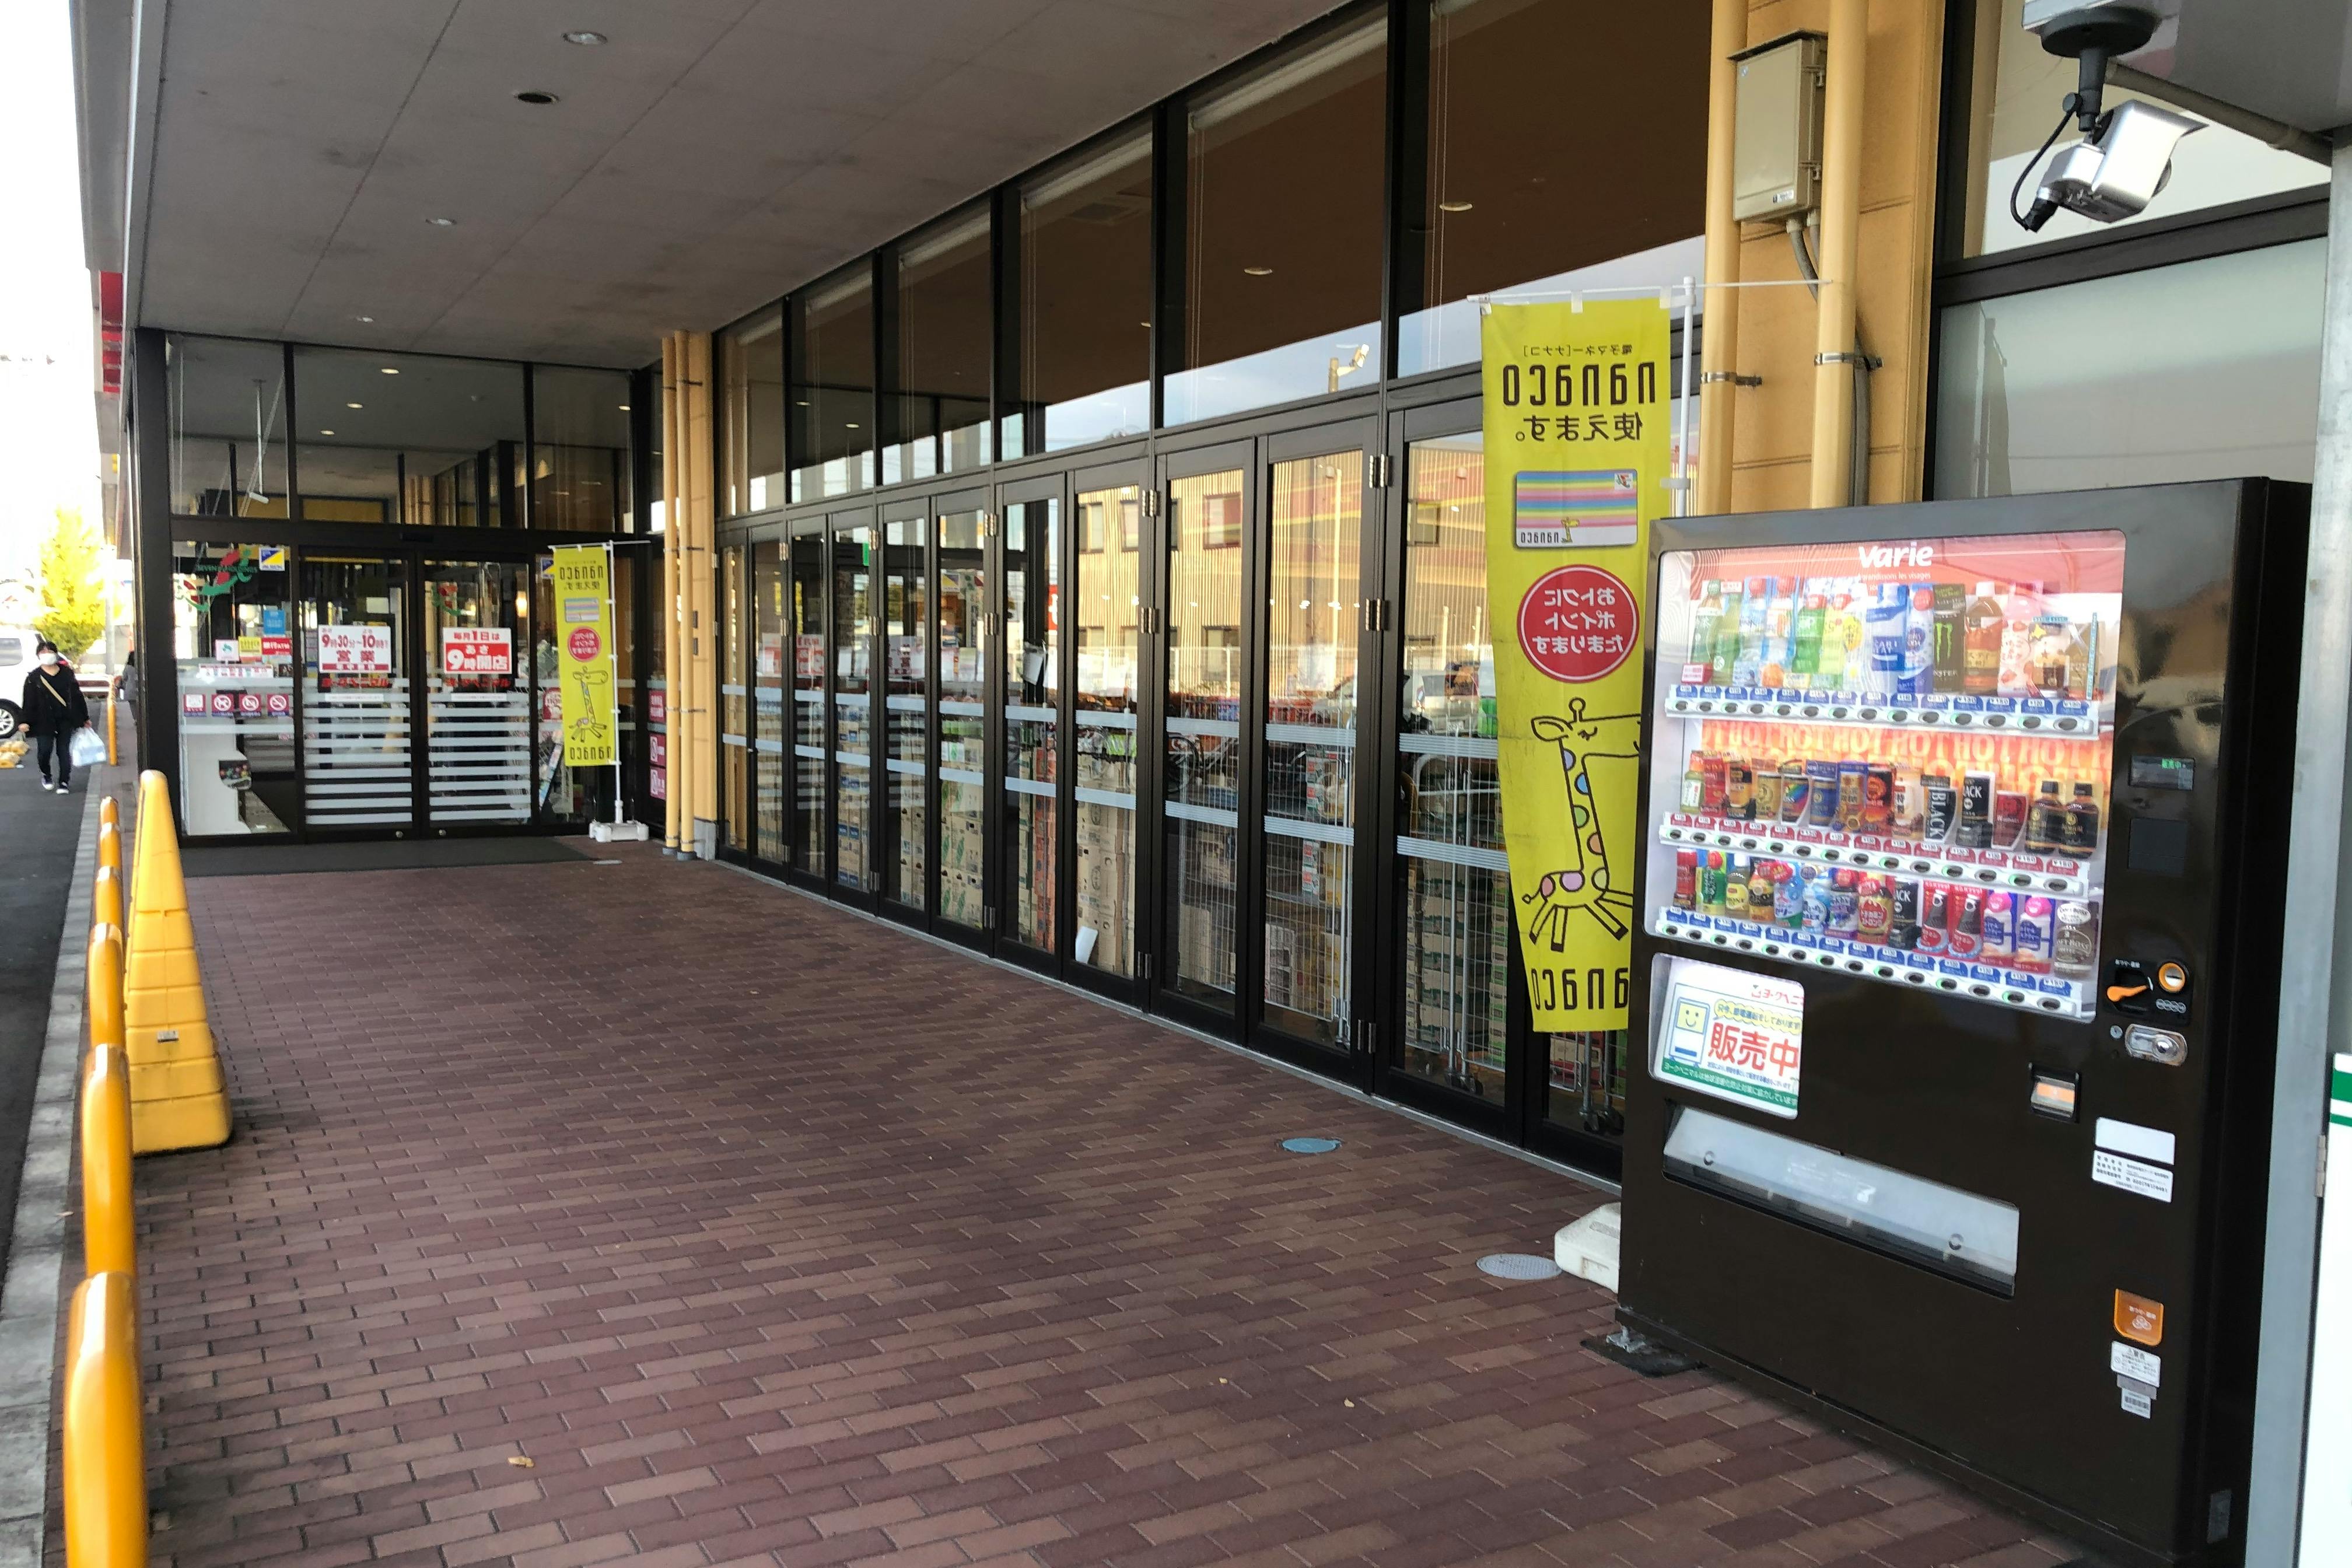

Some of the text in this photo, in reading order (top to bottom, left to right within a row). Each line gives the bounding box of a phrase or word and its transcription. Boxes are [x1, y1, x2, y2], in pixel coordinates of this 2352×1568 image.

[1859, 541, 1933, 569] Varie
[1930, 792, 1947, 838] BLACK
[1707, 1022, 1799, 1076] 販売中
